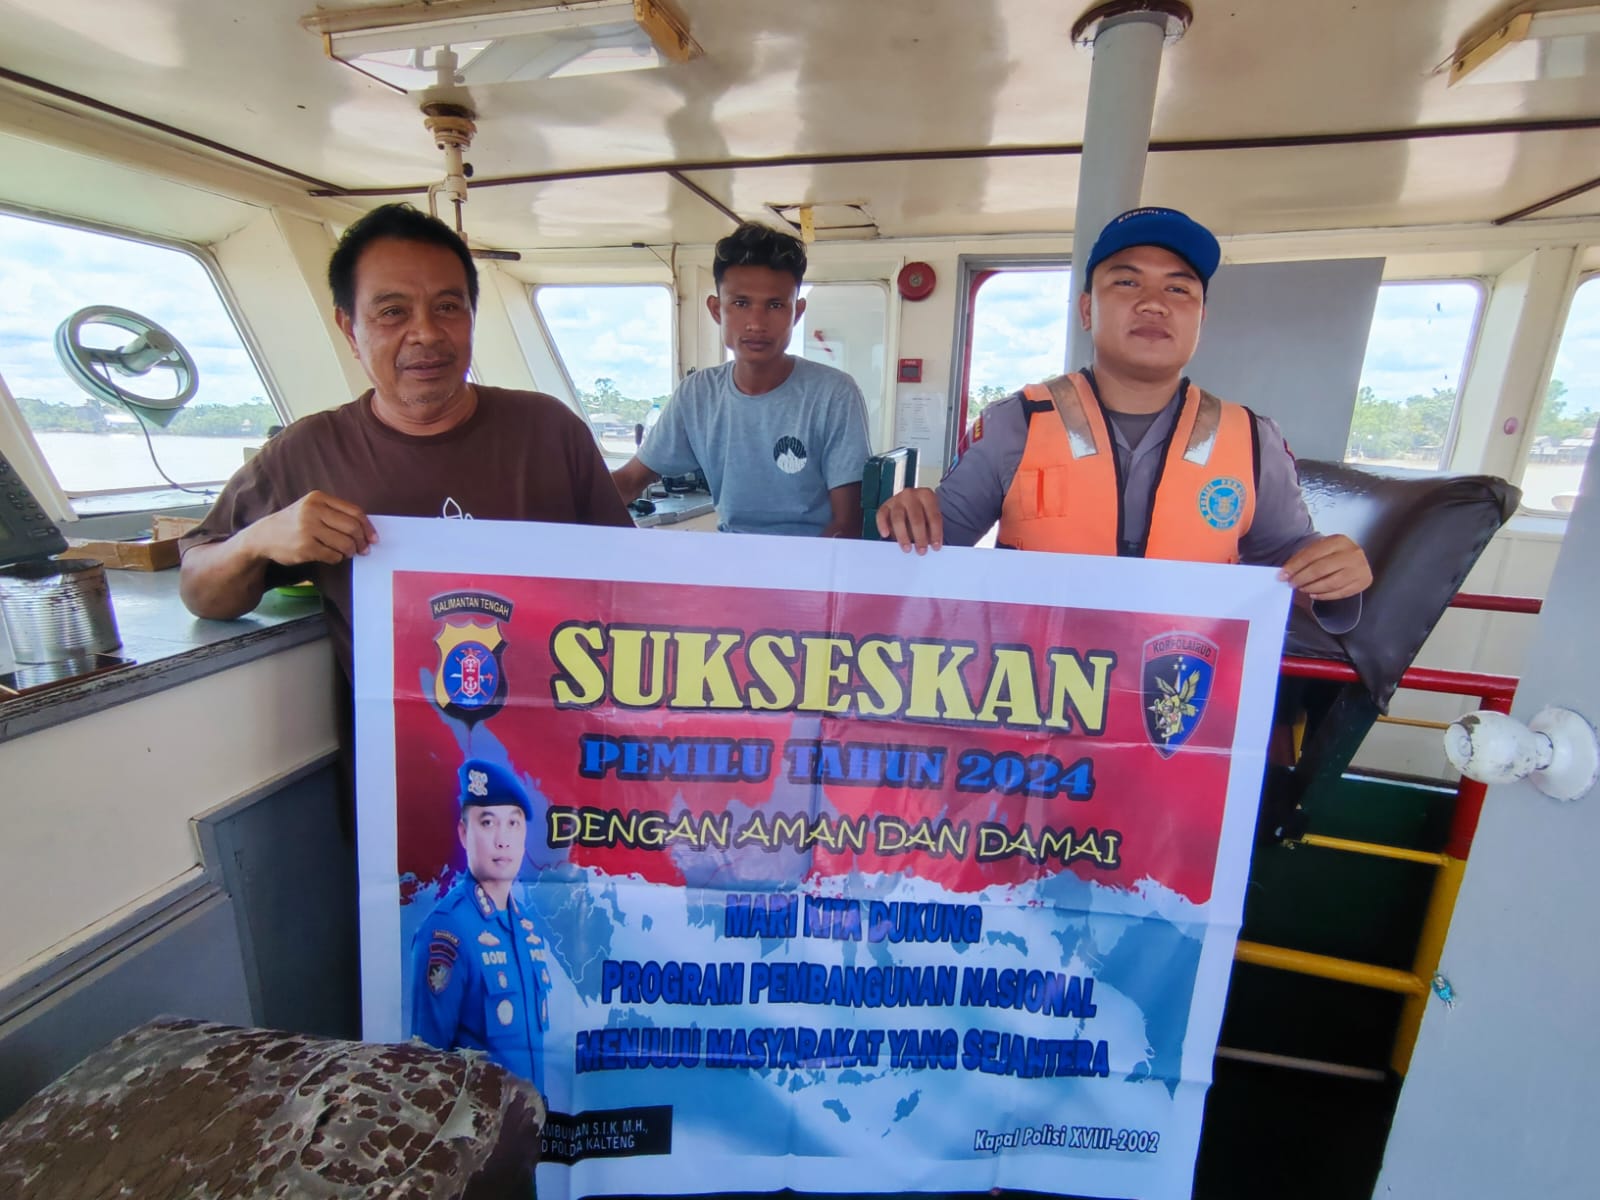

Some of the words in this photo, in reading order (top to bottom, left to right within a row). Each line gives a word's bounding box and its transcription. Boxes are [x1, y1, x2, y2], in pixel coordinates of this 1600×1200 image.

[434, 597, 479, 614] KALIMANTAN
[480, 599, 509, 616] TENGAH
[1153, 639, 1212, 657] KORPOLAIRUD
[551, 622, 1116, 734] SUKSESKAN
[581, 737, 774, 781] PEMILU
[785, 741, 947, 787] TAHUN
[956, 751, 1095, 800] 2024
[550, 810, 730, 847] DENGAN
[736, 814, 867, 850] AMAN
[877, 820, 968, 857] DAN
[978, 826, 1121, 866] DAMAI
[725, 894, 798, 938] MARI
[803, 895, 862, 941] KITA
[868, 901, 982, 943] DUKUNG
[602, 961, 745, 1005] PROGRAM
[749, 961, 957, 1008] PEMBANGUNAN
[961, 967, 1097, 1018] NASIONAL
[576, 1028, 700, 1074] MENJUJU
[705, 1027, 884, 1070] MASYARAKAT
[888, 1029, 959, 1070] YANG
[962, 1029, 1109, 1078] SEJAHTERA
[551, 1139, 582, 1157] POLDA
[586, 1134, 635, 1150] KALTENG
[975, 1130, 1020, 1152] Kapal
[1022, 1125, 1067, 1146] Polisi
[1069, 1127, 1159, 1153] XVIII-2002
